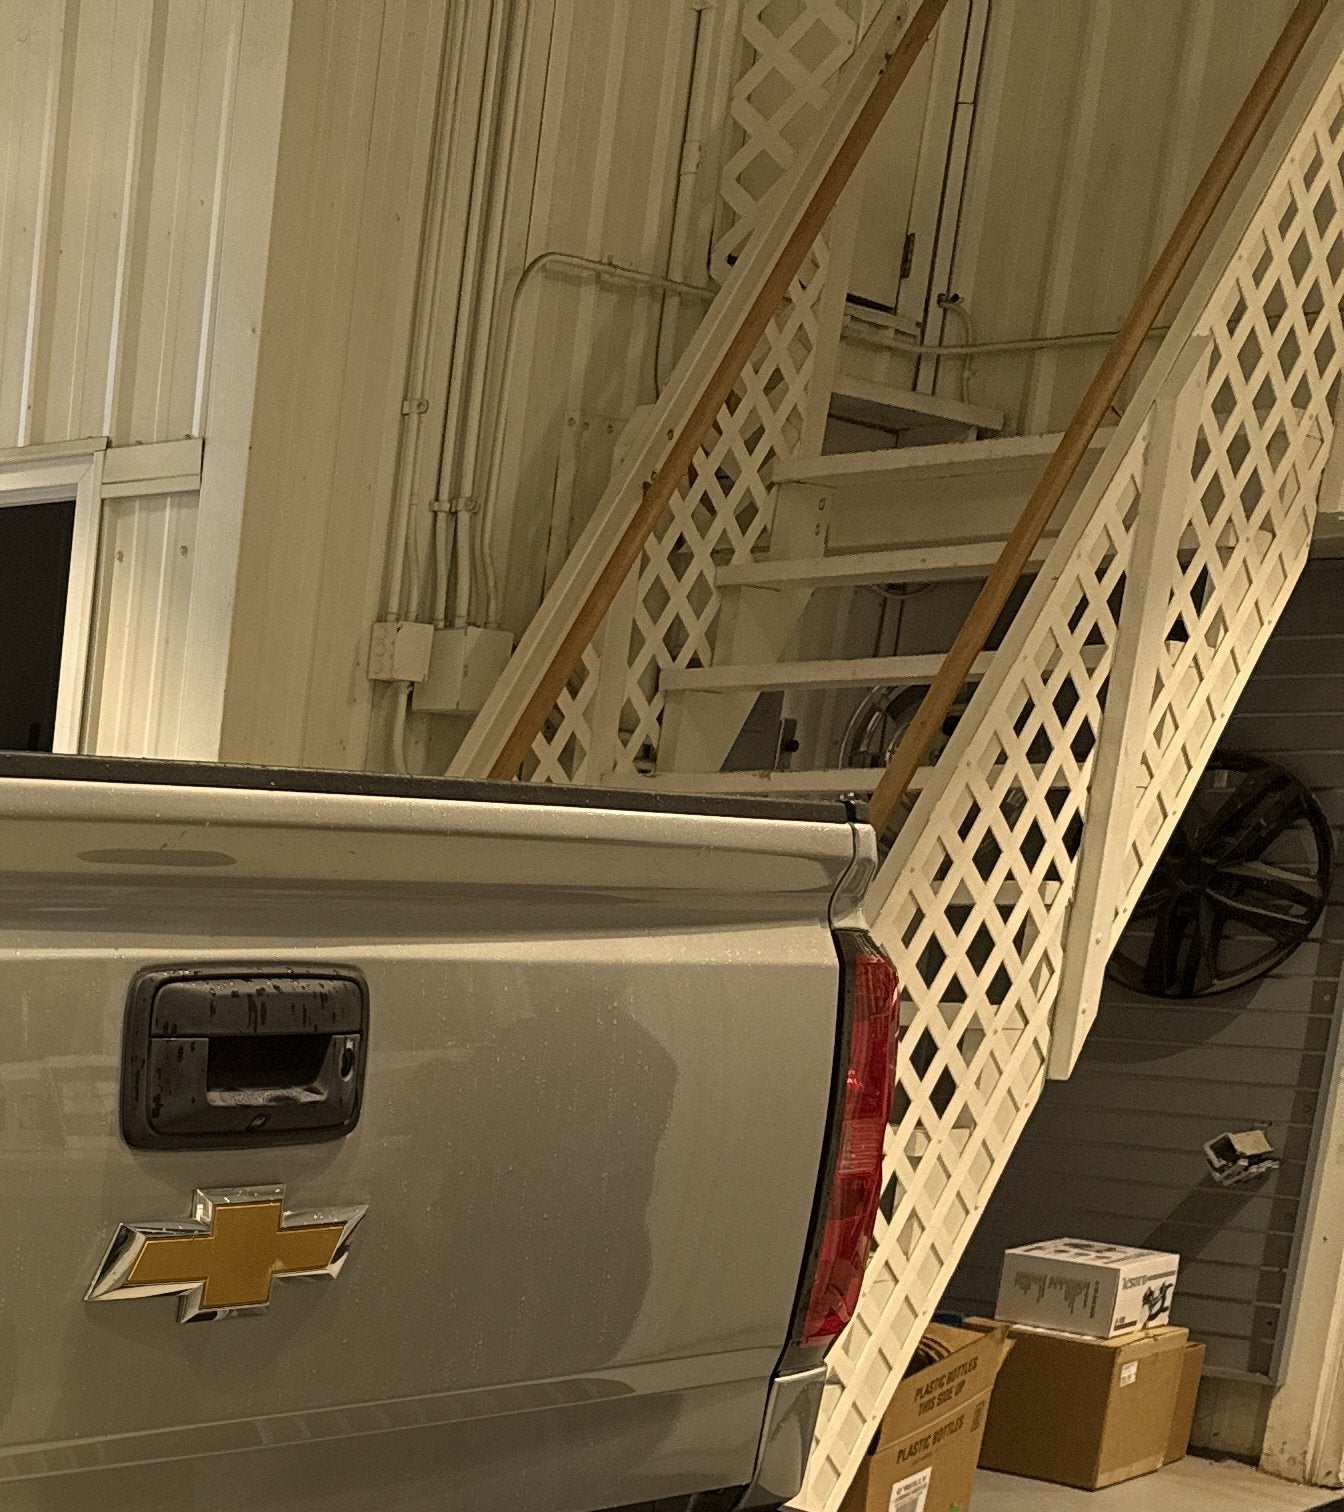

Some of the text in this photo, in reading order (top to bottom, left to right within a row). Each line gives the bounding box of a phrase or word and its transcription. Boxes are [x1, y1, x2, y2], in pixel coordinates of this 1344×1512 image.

[914, 1356, 979, 1402] PLASTIC BOTTLES
[918, 1379, 966, 1417] THIS SIDE UP
[896, 1434, 931, 1464] PLASTIC
[932, 1415, 965, 1446] BOTTLES
